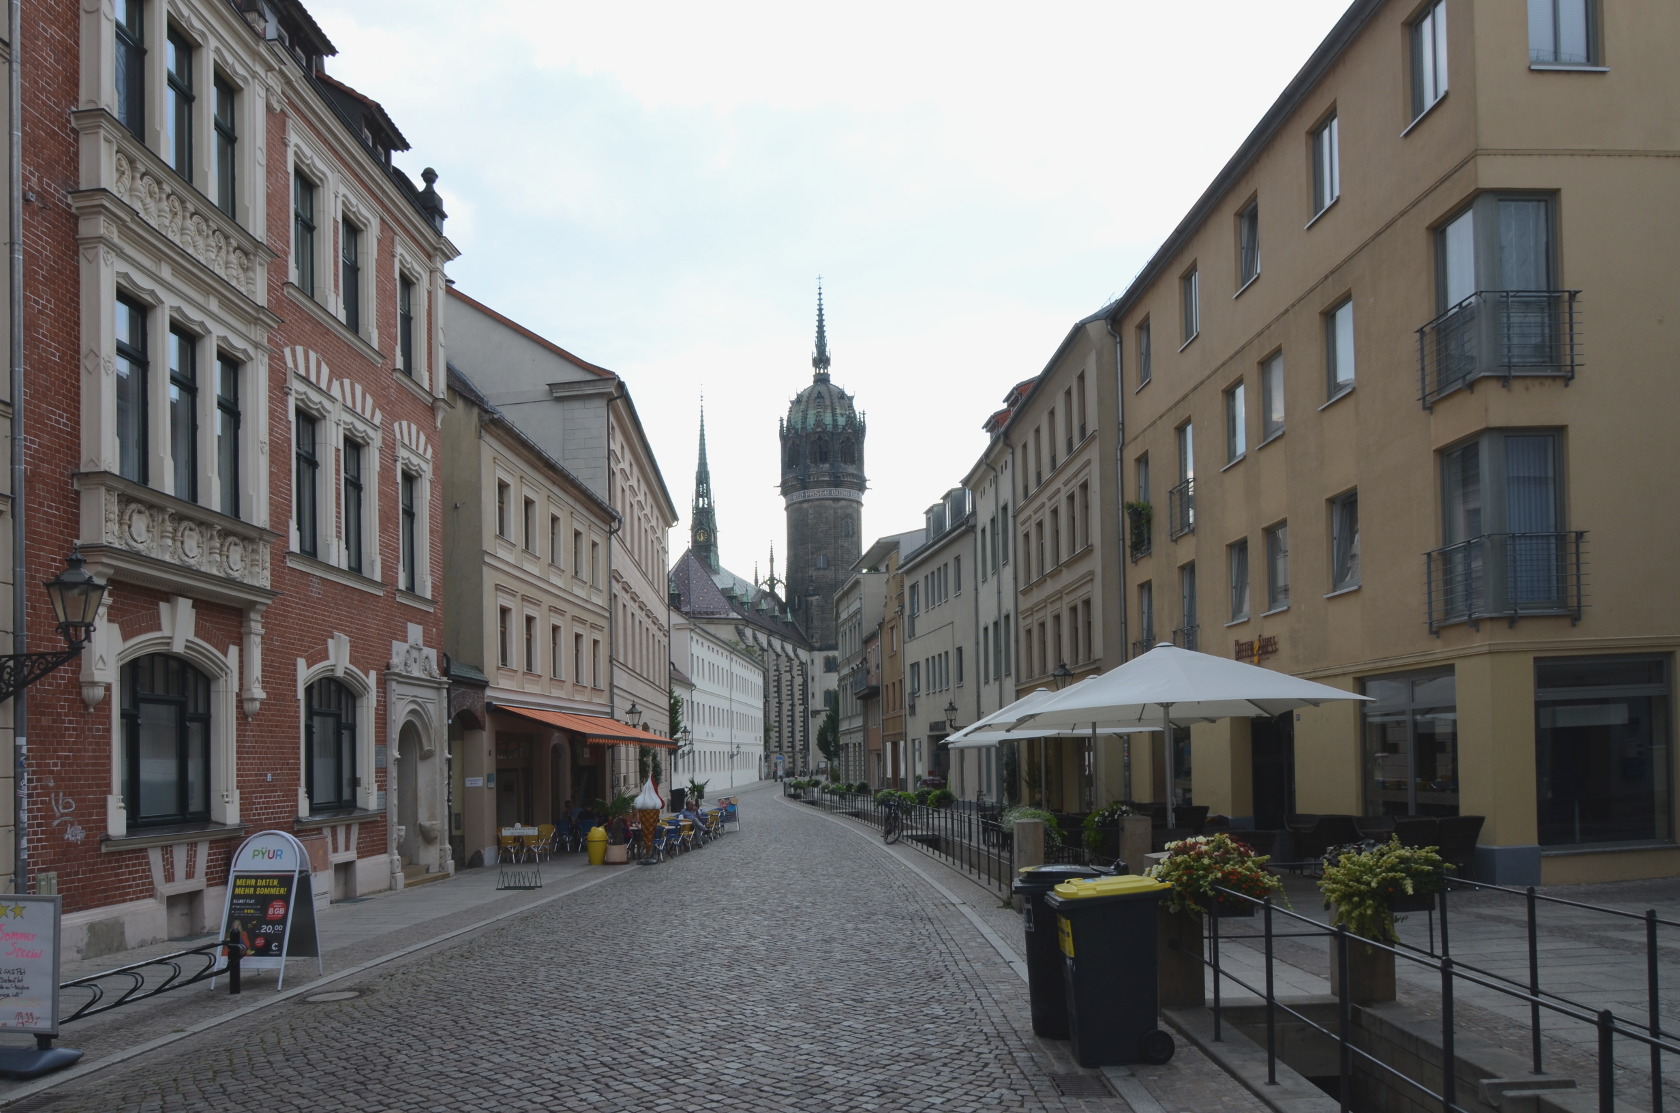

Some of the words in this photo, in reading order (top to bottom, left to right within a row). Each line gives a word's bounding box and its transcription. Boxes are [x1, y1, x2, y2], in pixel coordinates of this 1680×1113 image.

[252, 847, 284, 860] PŸUR
[257, 878, 280, 887] DATEN,
[234, 887, 254, 895] MEHR
[255, 887, 287, 895] SOMMER!
[274, 907, 285, 915] GB
